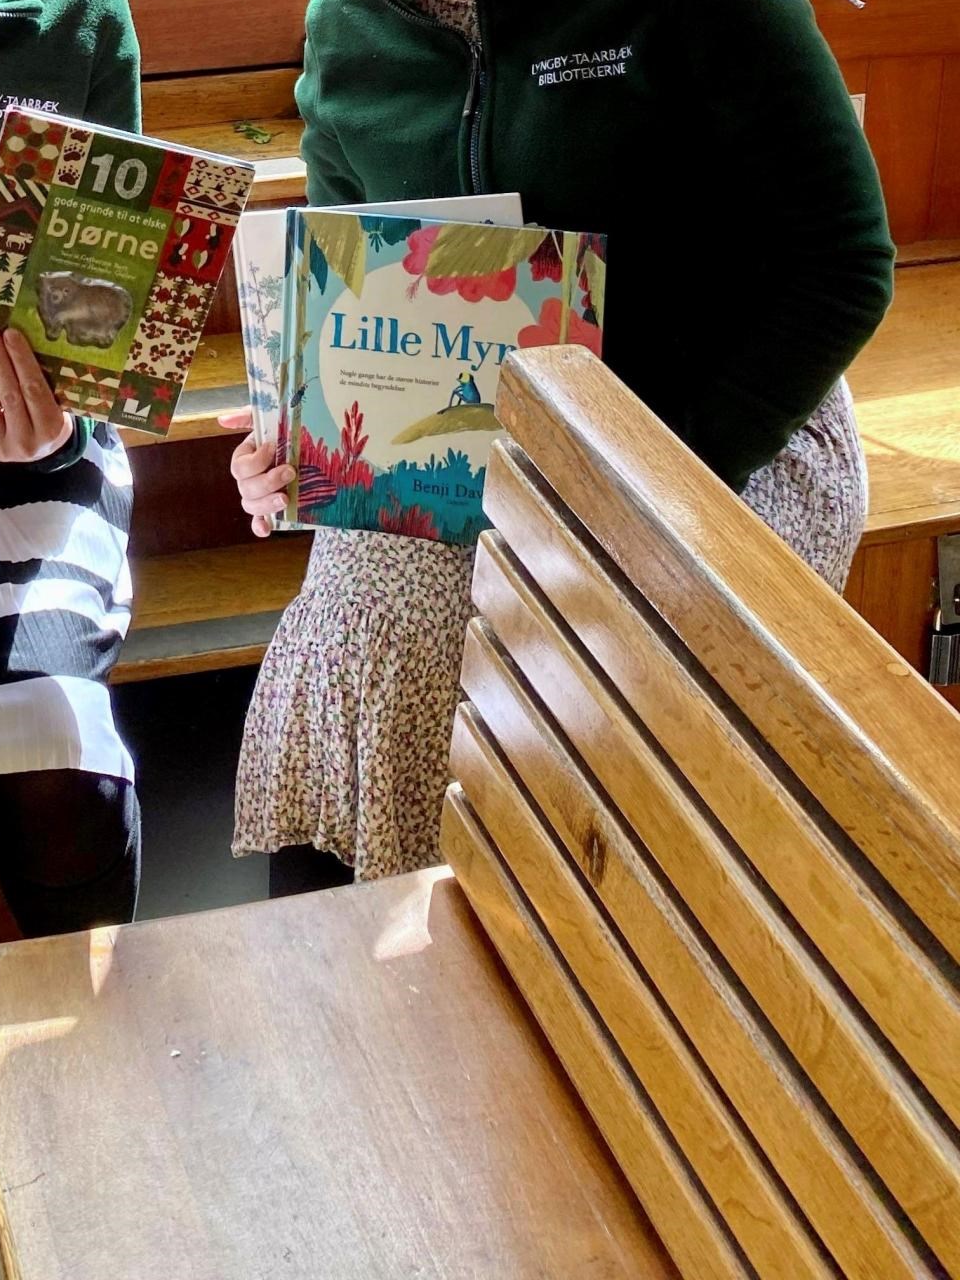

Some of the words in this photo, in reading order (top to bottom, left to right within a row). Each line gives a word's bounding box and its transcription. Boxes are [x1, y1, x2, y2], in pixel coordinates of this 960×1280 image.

[538, 62, 627, 86] BIBLIOTEKERNE
[91, 153, 148, 200] 10
[54, 197, 78, 207] gode
[80, 202, 114, 218] grunde
[117, 210, 127, 220] til
[130, 214, 141, 224] at
[142, 216, 167, 230] elske
[46, 209, 159, 260] bjørne
[330, 312, 422, 357] Lille
[432, 322, 517, 371] Myr
[413, 478, 449, 496] Benji
[455, 484, 483, 499] Dav
